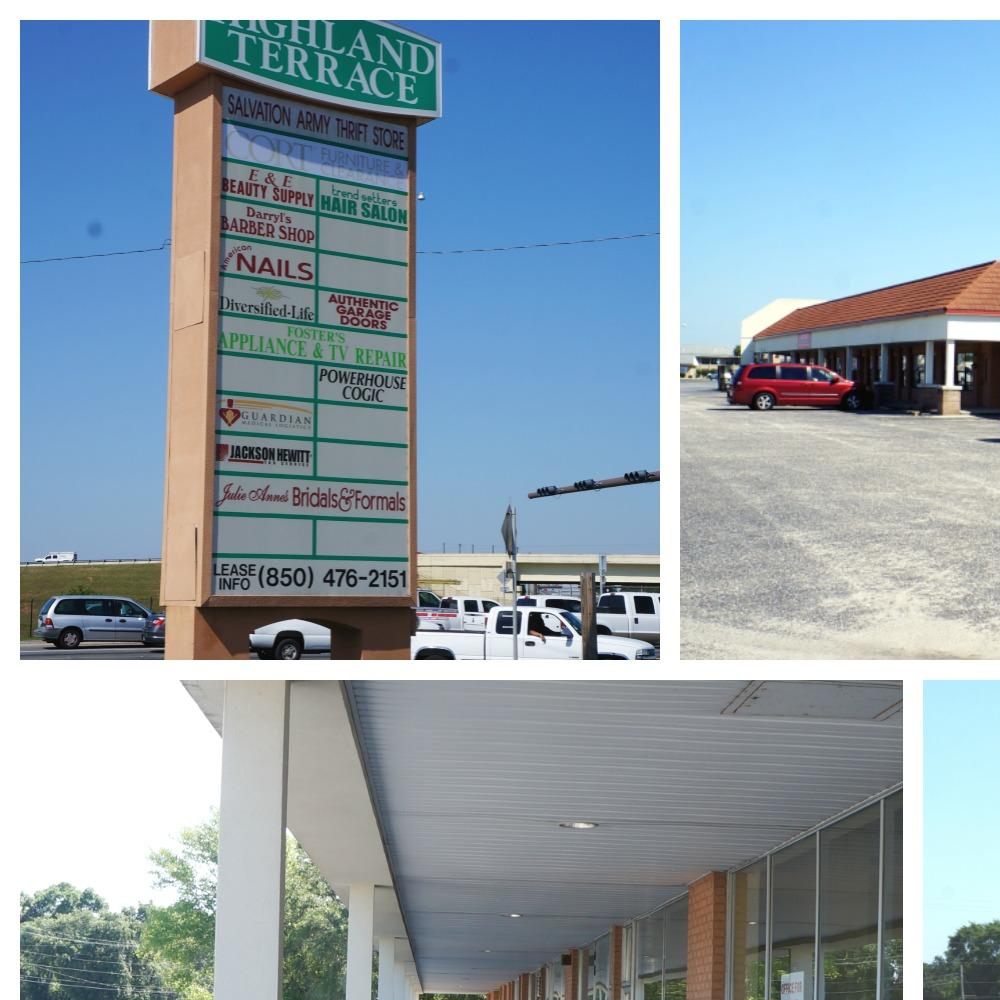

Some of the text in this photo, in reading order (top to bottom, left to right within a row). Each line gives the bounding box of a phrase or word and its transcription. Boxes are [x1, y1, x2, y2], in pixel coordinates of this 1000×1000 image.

[210, 20, 435, 75] GHLAND
[227, 29, 418, 105] TERRACE
[227, 94, 404, 151] SALVATION ARMY THRIFT STORE
[228, 130, 313, 170] CORT
[321, 147, 390, 175] FURNITURE
[248, 169, 293, 188] E & E
[222, 177, 314, 208] BEAUTY SUPPLY
[332, 185, 397, 207] trend setters
[246, 206, 292, 224] Darryl's
[321, 195, 408, 225] HAIR SALON
[221, 216, 315, 244] BARBER SHOP
[220, 244, 252, 271] American
[236, 252, 314, 281] NAILS
[219, 296, 314, 321] Diversified-Life
[328, 294, 400, 312] AUTHENTIC
[336, 304, 391, 321] GARAGE
[287, 325, 346, 344] FOSTER'S
[340, 315, 388, 330] DOORS
[218, 332, 407, 369] APPLIANCE & TV REPAIR
[319, 368, 407, 390] POWERHOUSE
[342, 386, 385, 403] COGIC
[241, 411, 312, 424] GUARDIAN
[230, 445, 311, 464] JACKSON HEWITT
[216, 482, 247, 507] Julie
[213, 563, 256, 577] LEASE
[258, 564, 408, 589] (850) 476-2151
[218, 577, 250, 591] INFO
